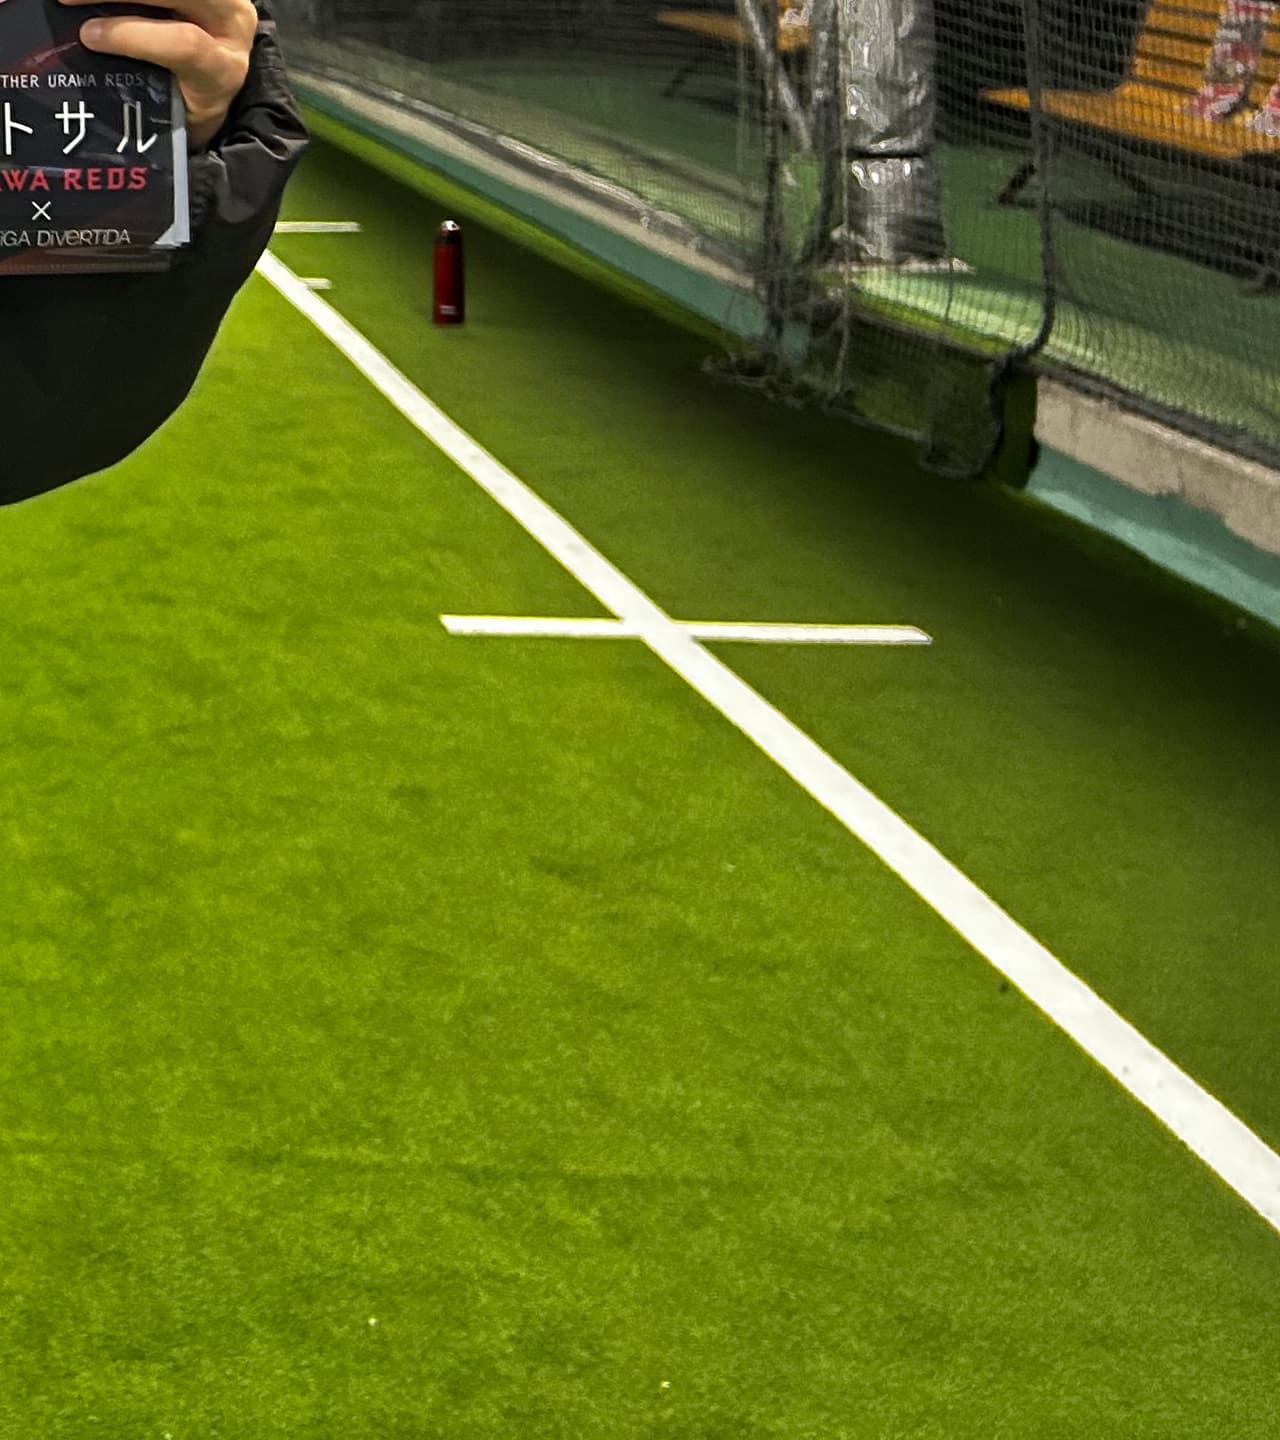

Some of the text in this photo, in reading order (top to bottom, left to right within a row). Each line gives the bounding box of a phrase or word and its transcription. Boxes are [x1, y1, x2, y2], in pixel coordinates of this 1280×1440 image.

[47, 73, 96, 88] URAWA
[105, 72, 143, 88] REDS
[64, 166, 148, 192] REDS
